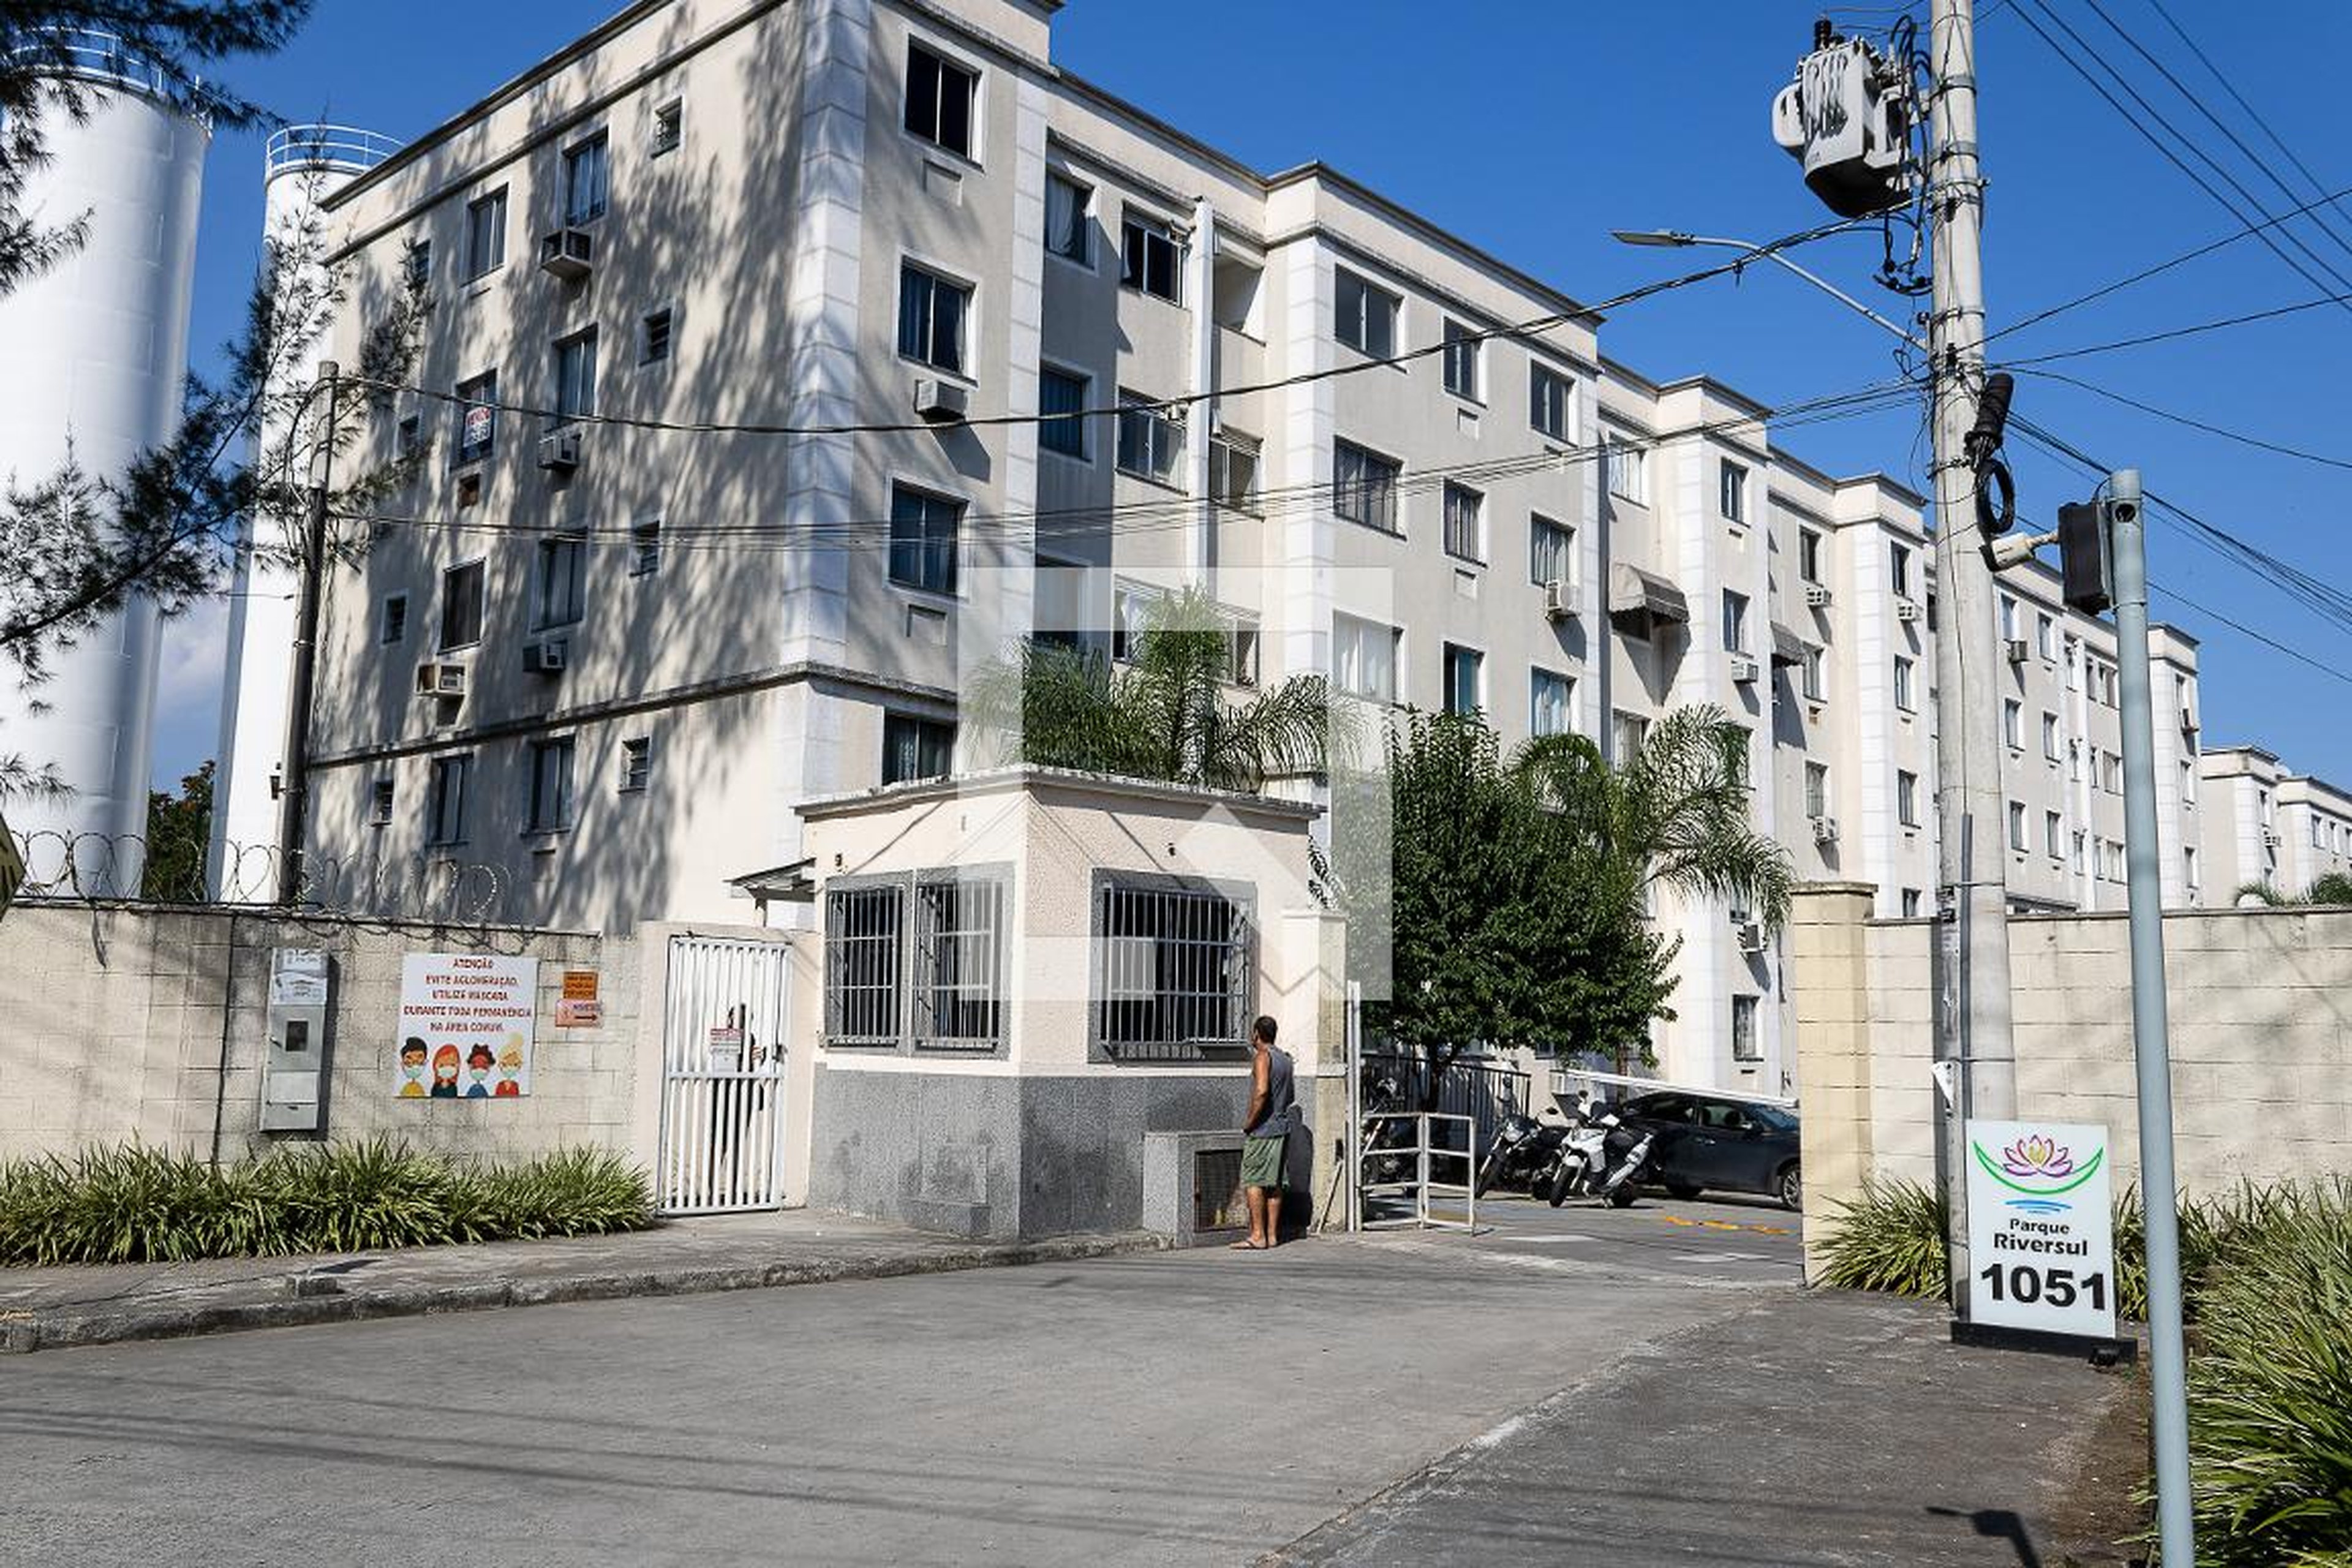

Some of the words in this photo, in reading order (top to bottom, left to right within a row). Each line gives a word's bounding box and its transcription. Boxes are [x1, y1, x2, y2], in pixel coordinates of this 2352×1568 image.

[426, 974, 451, 985] EVITE
[432, 989, 466, 1000] UTILIZE
[404, 1005, 447, 1016] DURANTE
[448, 1006, 471, 1017] TODA
[430, 1022, 443, 1032] NA
[2010, 1218, 2070, 1235] Parque
[1993, 1232, 2088, 1256] Riversul
[1980, 1263, 2106, 1311] 1051
